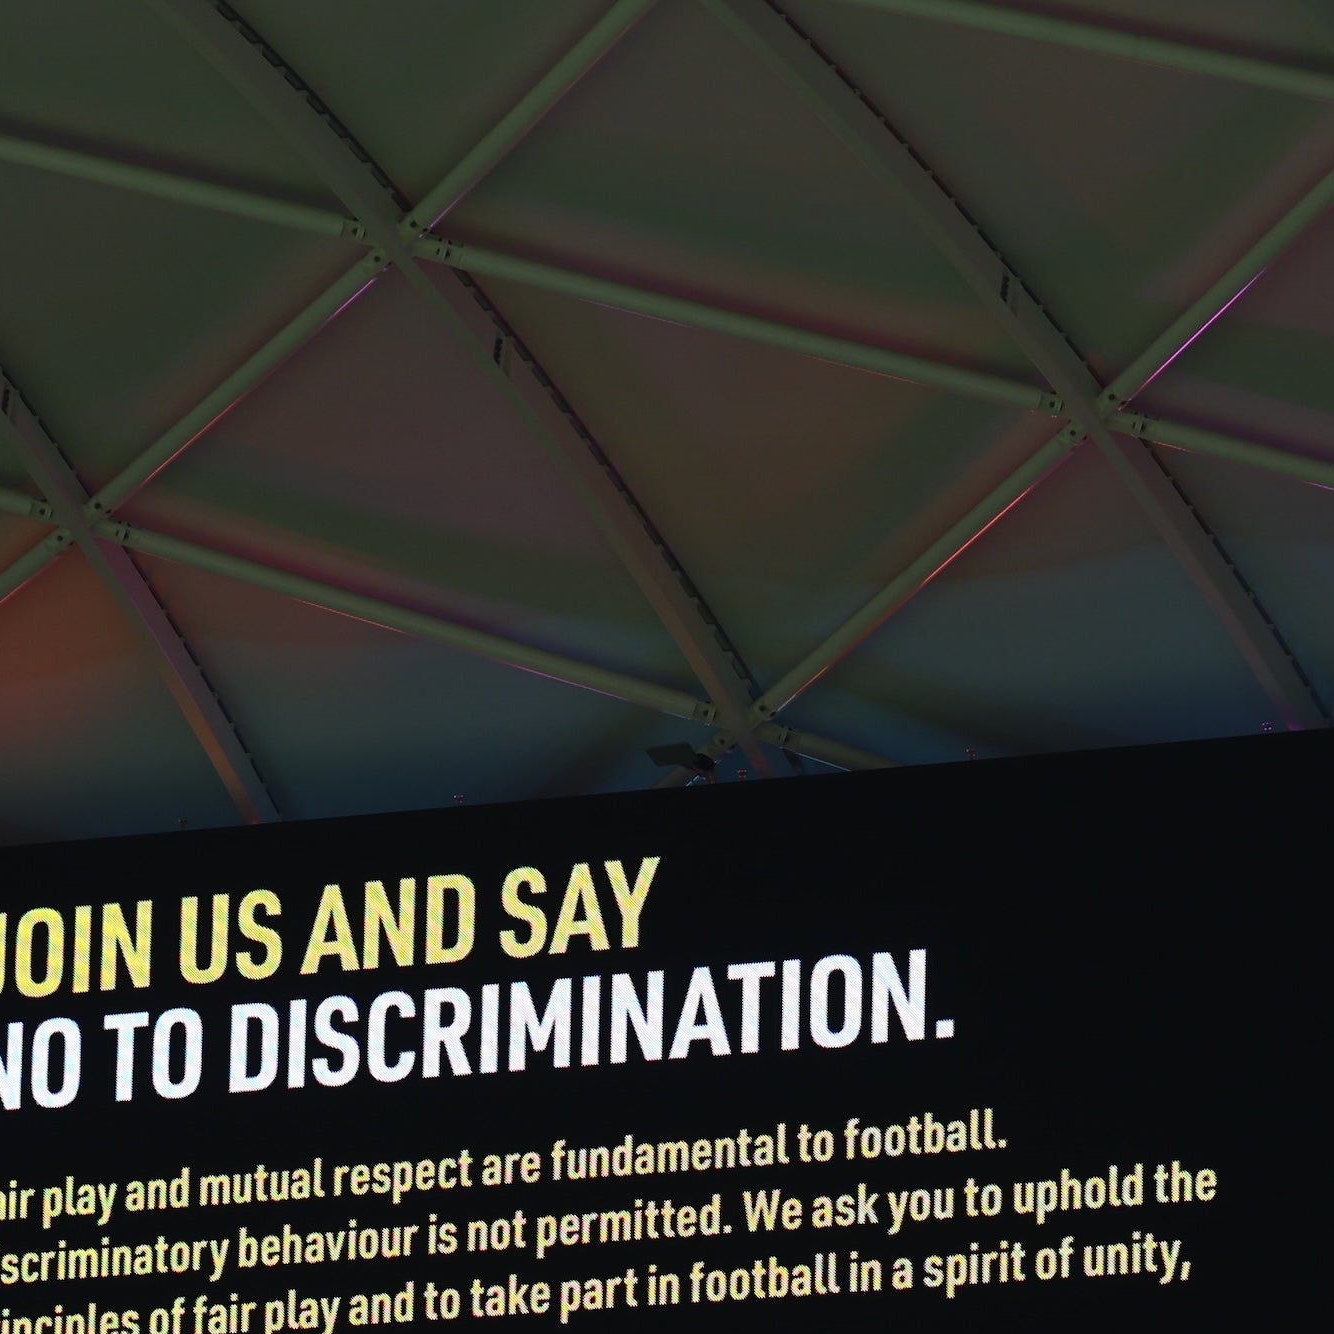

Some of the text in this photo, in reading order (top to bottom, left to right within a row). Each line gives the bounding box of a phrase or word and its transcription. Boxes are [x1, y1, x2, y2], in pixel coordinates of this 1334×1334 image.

[179, 889, 283, 984] US
[300, 874, 476, 975] AND
[499, 857, 660, 959] SAY
[103, 1007, 203, 1102] TO
[229, 948, 954, 1093] DISCRIMINATION.
[42, 1176, 117, 1229] play
[125, 1167, 190, 1212] and
[199, 1158, 325, 1206] mutual
[333, 1150, 472, 1204] respect
[482, 1152, 541, 1186] are
[551, 1123, 789, 1180] fundamental
[797, 1124, 834, 1162] to
[844, 1108, 1007, 1159] football.
[238, 1219, 419, 1268] behaviour
[428, 1214, 458, 1254] is
[467, 1210, 527, 1251] not
[536, 1194, 732, 1259] permitted.
[743, 1189, 803, 1232] We
[812, 1183, 878, 1228] ask
[888, 1188, 954, 1235] you
[964, 1178, 1002, 1217] to
[1013, 1163, 1143, 1225] uphold
[1154, 1161, 1217, 1203] the
[348, 1281, 414, 1326] and
[424, 1282, 460, 1320] to
[470, 1274, 551, 1318] take
[560, 1269, 638, 1324] part
[648, 1264, 680, 1306] in
[690, 1253, 840, 1303] football
[849, 1251, 882, 1292] in
[892, 1258, 913, 1290] a
[924, 1240, 1025, 1298] spirit
[1035, 1236, 1074, 1280] of
[1083, 1231, 1191, 1284] unity,
